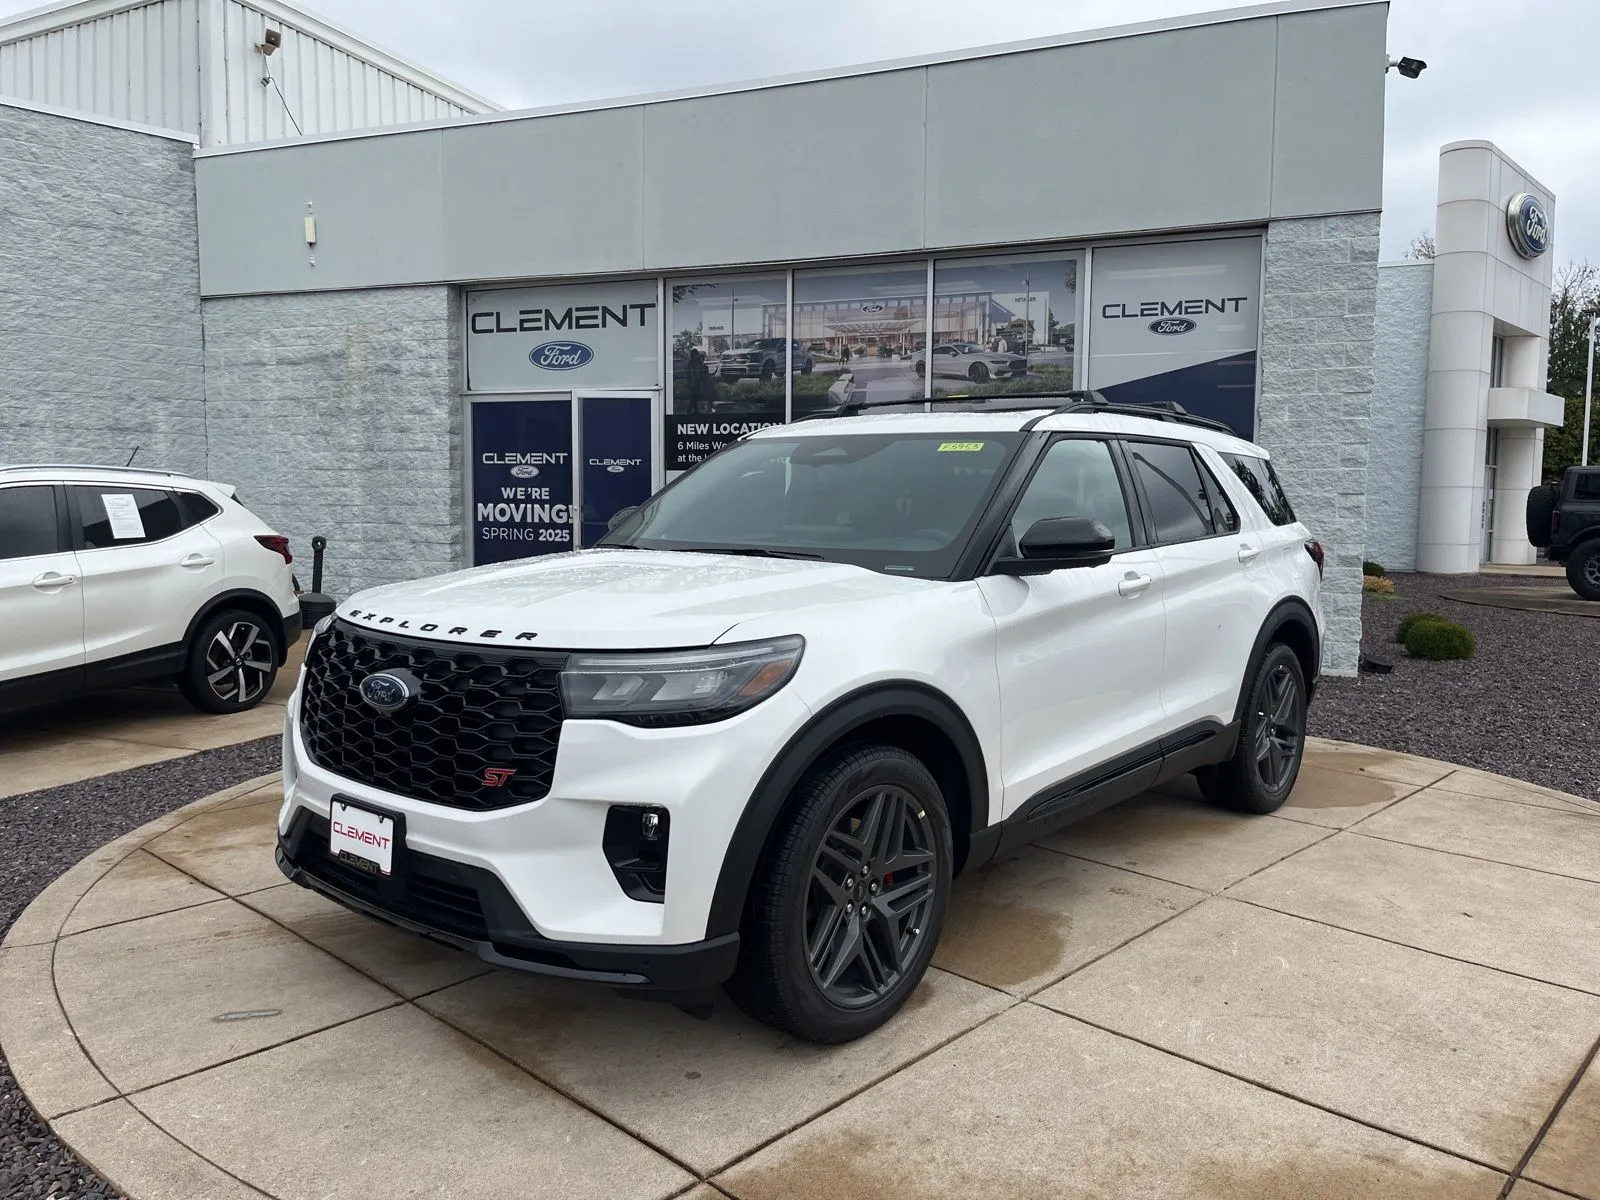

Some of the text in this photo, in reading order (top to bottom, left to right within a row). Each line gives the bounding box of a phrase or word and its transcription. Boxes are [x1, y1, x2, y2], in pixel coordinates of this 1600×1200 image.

[1527, 206, 1546, 244] Ford
[1102, 297, 1248, 318] CLEMENT
[471, 303, 656, 334] CLEMENT
[1157, 320, 1186, 333] Ford
[540, 345, 581, 365] Ford
[677, 422, 782, 435] NEW LOCATI
[677, 442, 684, 450] 6
[686, 441, 709, 450] Miles
[482, 452, 568, 464] CLEMENT
[589, 458, 642, 466] CLEMENT
[688, 453, 702, 462] the
[501, 487, 550, 499] WE'RE
[477, 503, 573, 524] MOVING!
[482, 527, 570, 542] SPRING 2025
[349, 609, 538, 641] EXPLORER
[481, 767, 517, 787] ST
[333, 821, 390, 849] CLEMENT
[340, 851, 378, 874] CLEMENT
